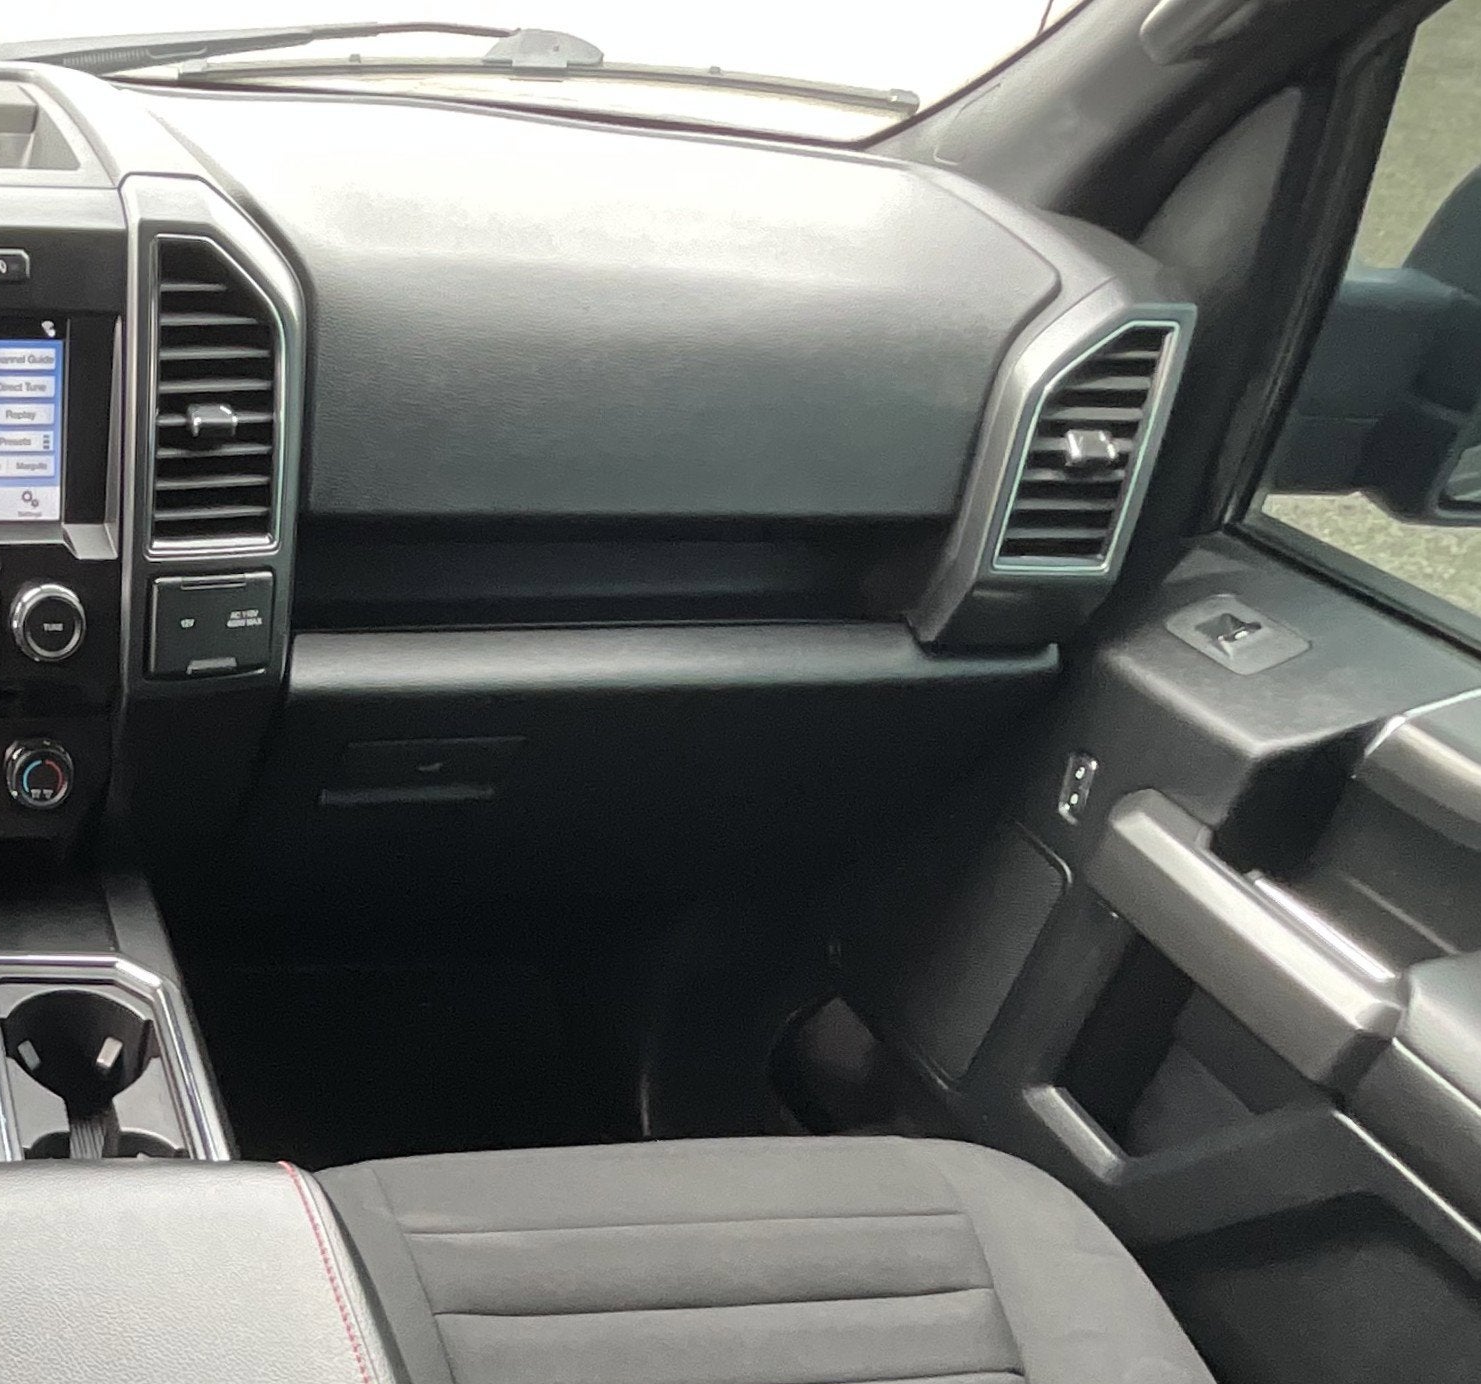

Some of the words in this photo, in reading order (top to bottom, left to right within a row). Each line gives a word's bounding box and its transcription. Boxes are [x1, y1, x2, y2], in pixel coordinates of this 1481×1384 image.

[28, 353, 55, 364] Guide
[25, 381, 47, 392] Tune
[5, 409, 36, 421] Replay
